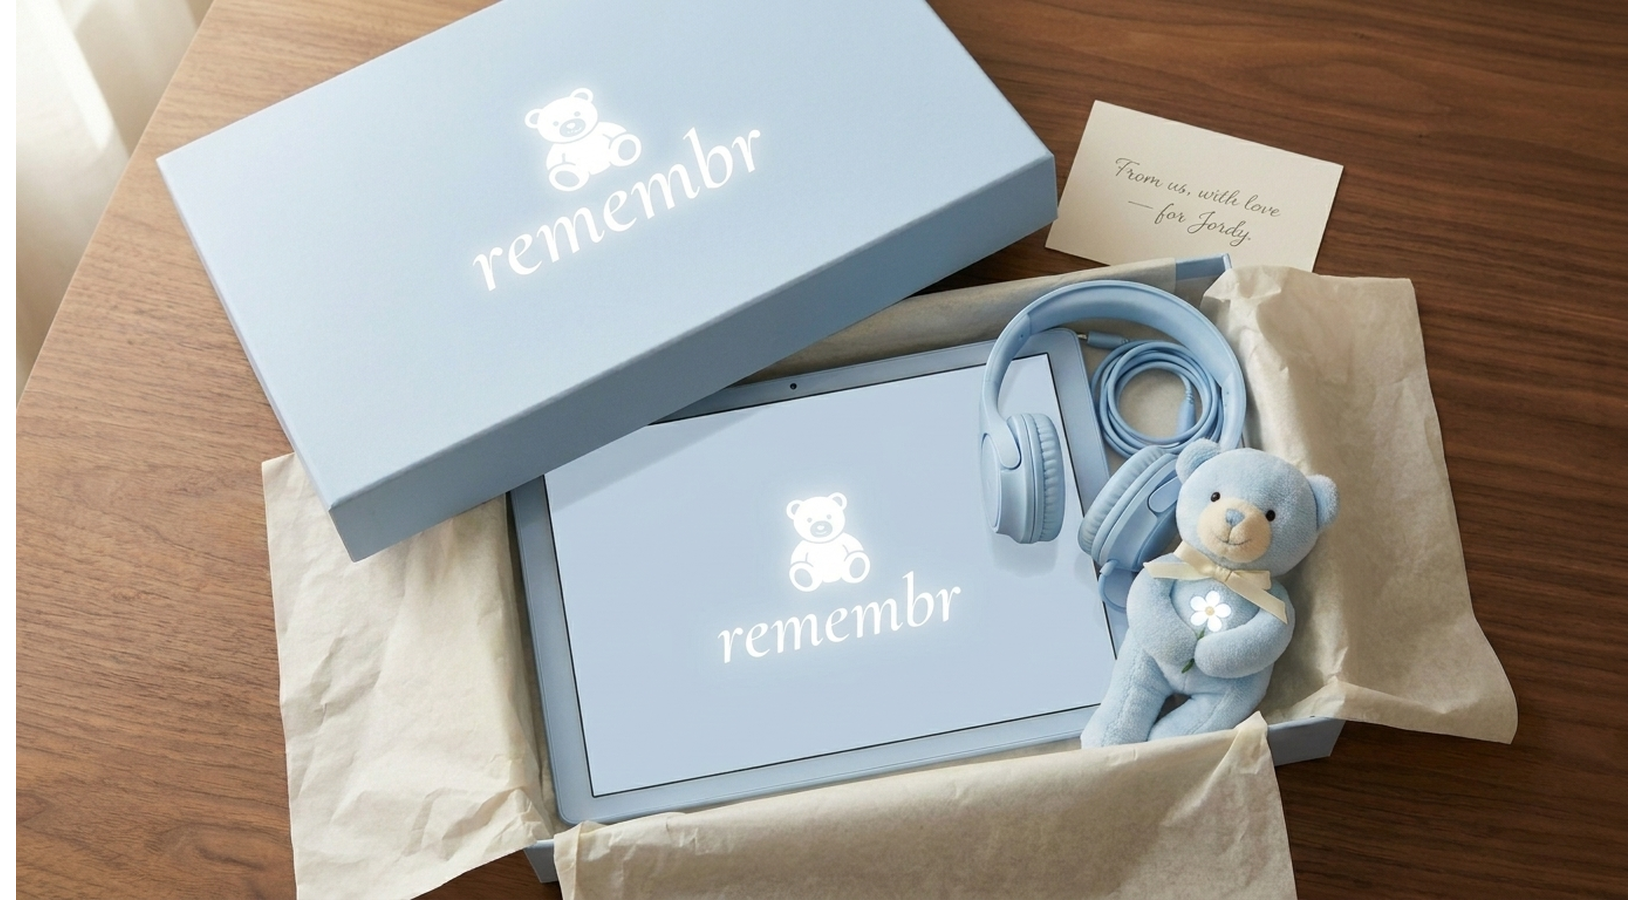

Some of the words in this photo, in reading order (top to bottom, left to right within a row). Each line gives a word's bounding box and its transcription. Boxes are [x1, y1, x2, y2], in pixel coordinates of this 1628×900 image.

[473, 126, 762, 291] remembr
[1115, 157, 1163, 188] From
[1167, 181, 1191, 196] us,
[1198, 189, 1241, 207] with
[1244, 194, 1281, 217] love
[1154, 202, 1186, 224] for
[1186, 211, 1251, 247] Jordy.
[717, 570, 961, 664] remembr
